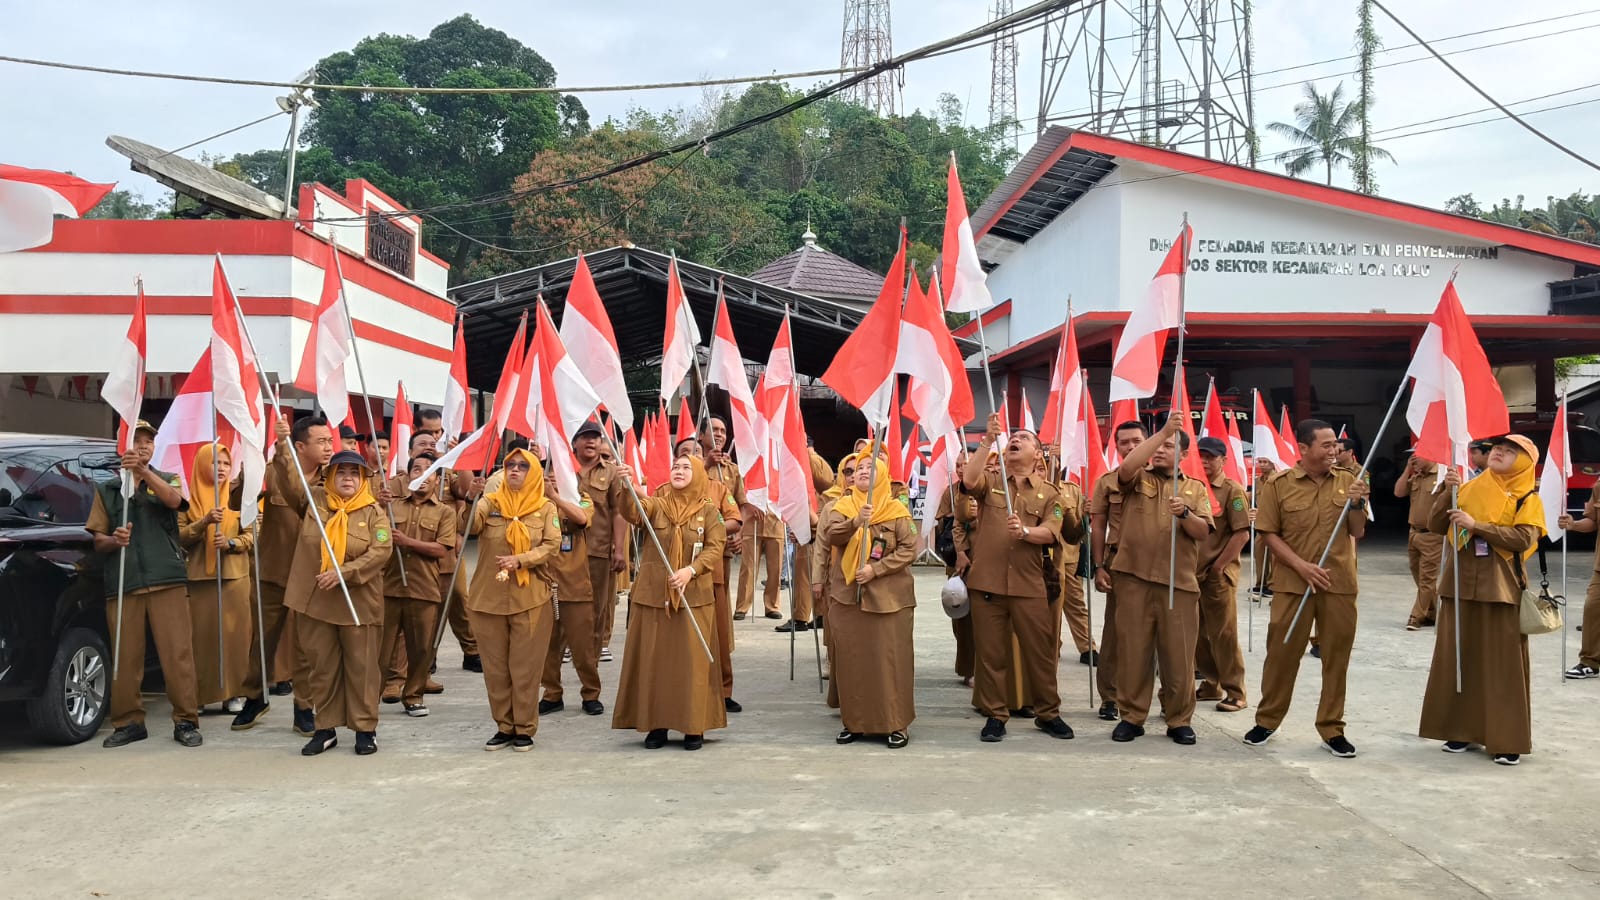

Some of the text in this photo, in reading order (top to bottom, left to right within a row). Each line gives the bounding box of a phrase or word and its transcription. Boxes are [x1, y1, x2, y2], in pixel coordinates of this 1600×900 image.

[1199, 239, 1265, 254] PEMADAM
[1271, 241, 1356, 257] KEBAKARAN
[1362, 243, 1390, 257] DAN
[1395, 245, 1498, 260] PENYELAMATAN
[1188, 258, 1430, 278] OS SEKTOR KECAMATAN LOA KULU
